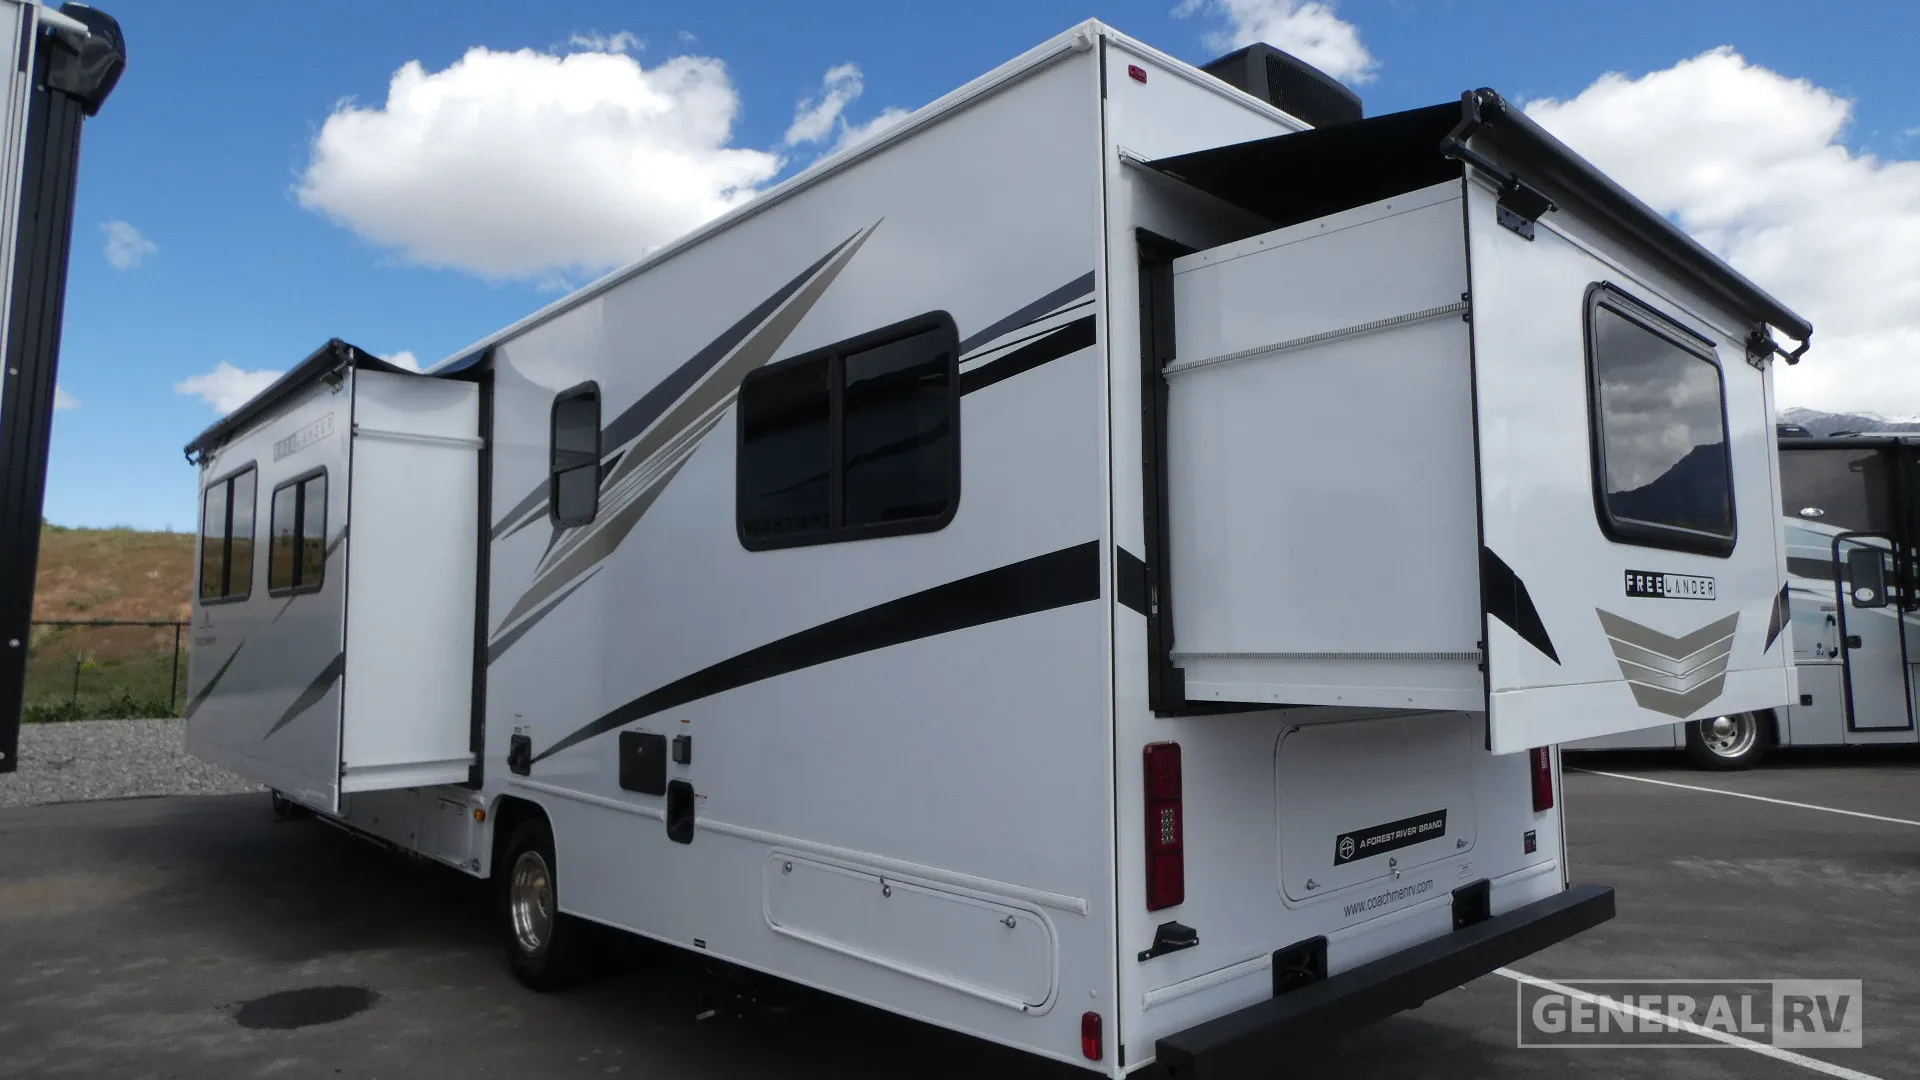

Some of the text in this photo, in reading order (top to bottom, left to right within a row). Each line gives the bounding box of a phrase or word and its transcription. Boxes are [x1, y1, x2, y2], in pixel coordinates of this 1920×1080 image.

[1626, 574, 1713, 595] FREELANDER
[1359, 819, 1443, 849] A FOREST RIVER BRAND
[1343, 879, 1433, 917] www.coachmenrv.com
